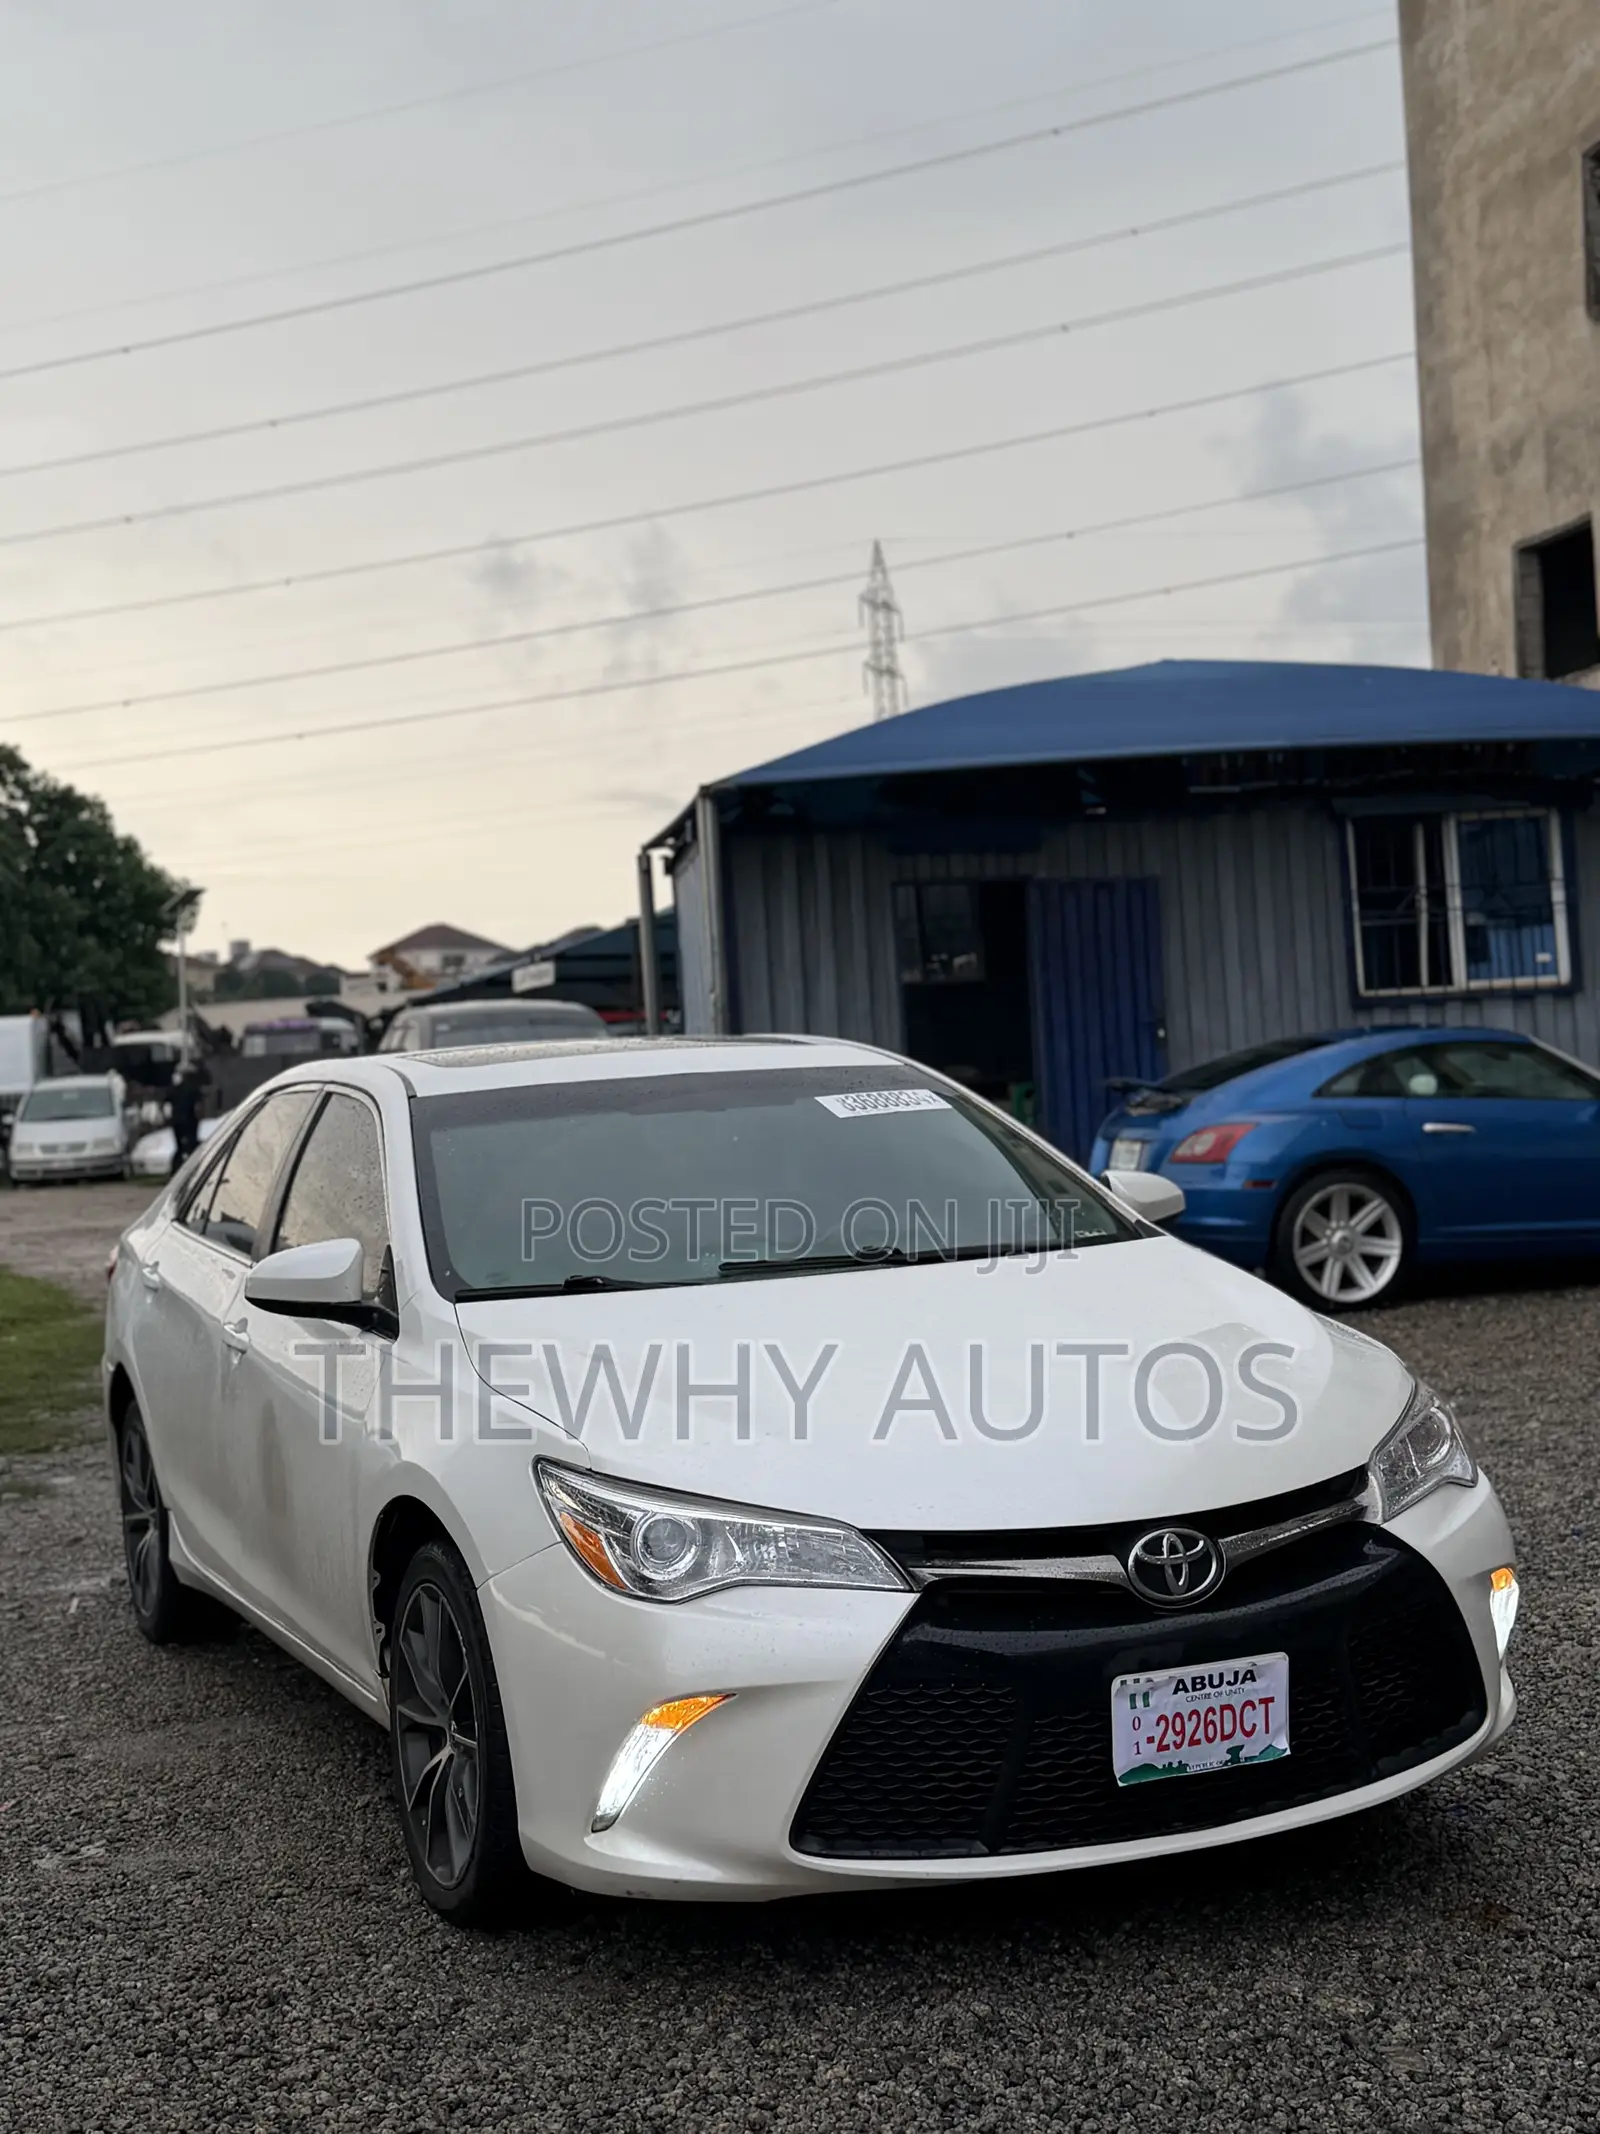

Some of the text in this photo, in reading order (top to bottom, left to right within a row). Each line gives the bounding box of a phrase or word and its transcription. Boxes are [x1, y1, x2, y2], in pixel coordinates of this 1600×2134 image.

[1171, 1669, 1257, 1695] ABUJA
[1185, 1692, 1212, 1703] CENTRE
[1225, 1687, 1245, 1697] UNITY
